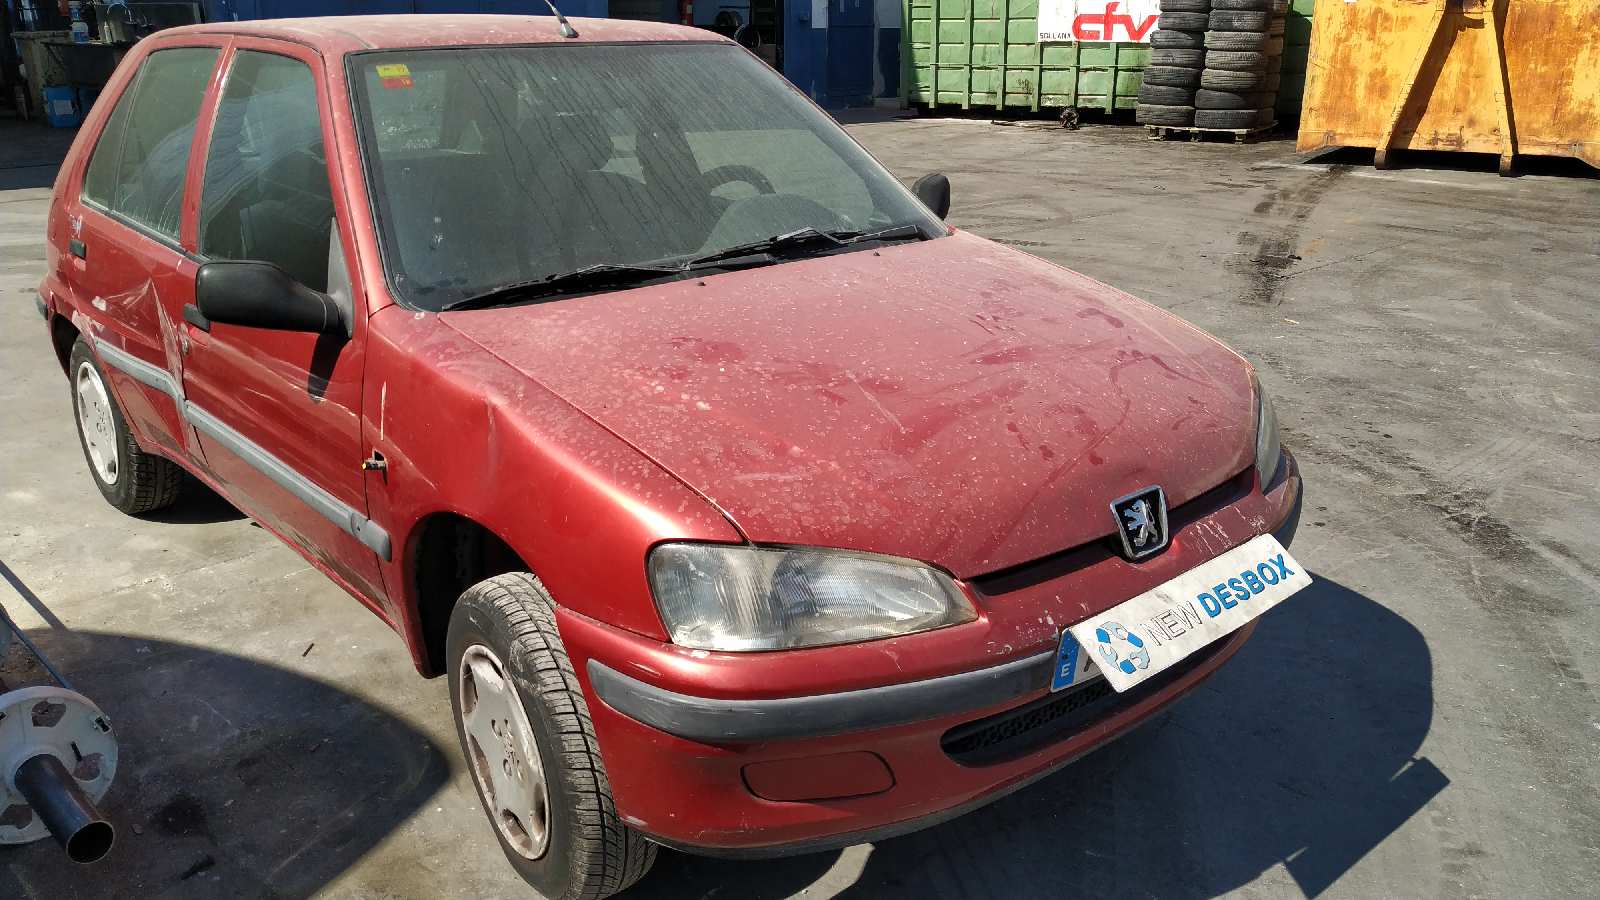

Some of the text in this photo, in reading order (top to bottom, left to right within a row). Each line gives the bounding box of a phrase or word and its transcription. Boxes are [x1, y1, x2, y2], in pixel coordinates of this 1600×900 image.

[1145, 553, 1295, 646] NEW DESBOX
[1060, 662, 1071, 678] E
